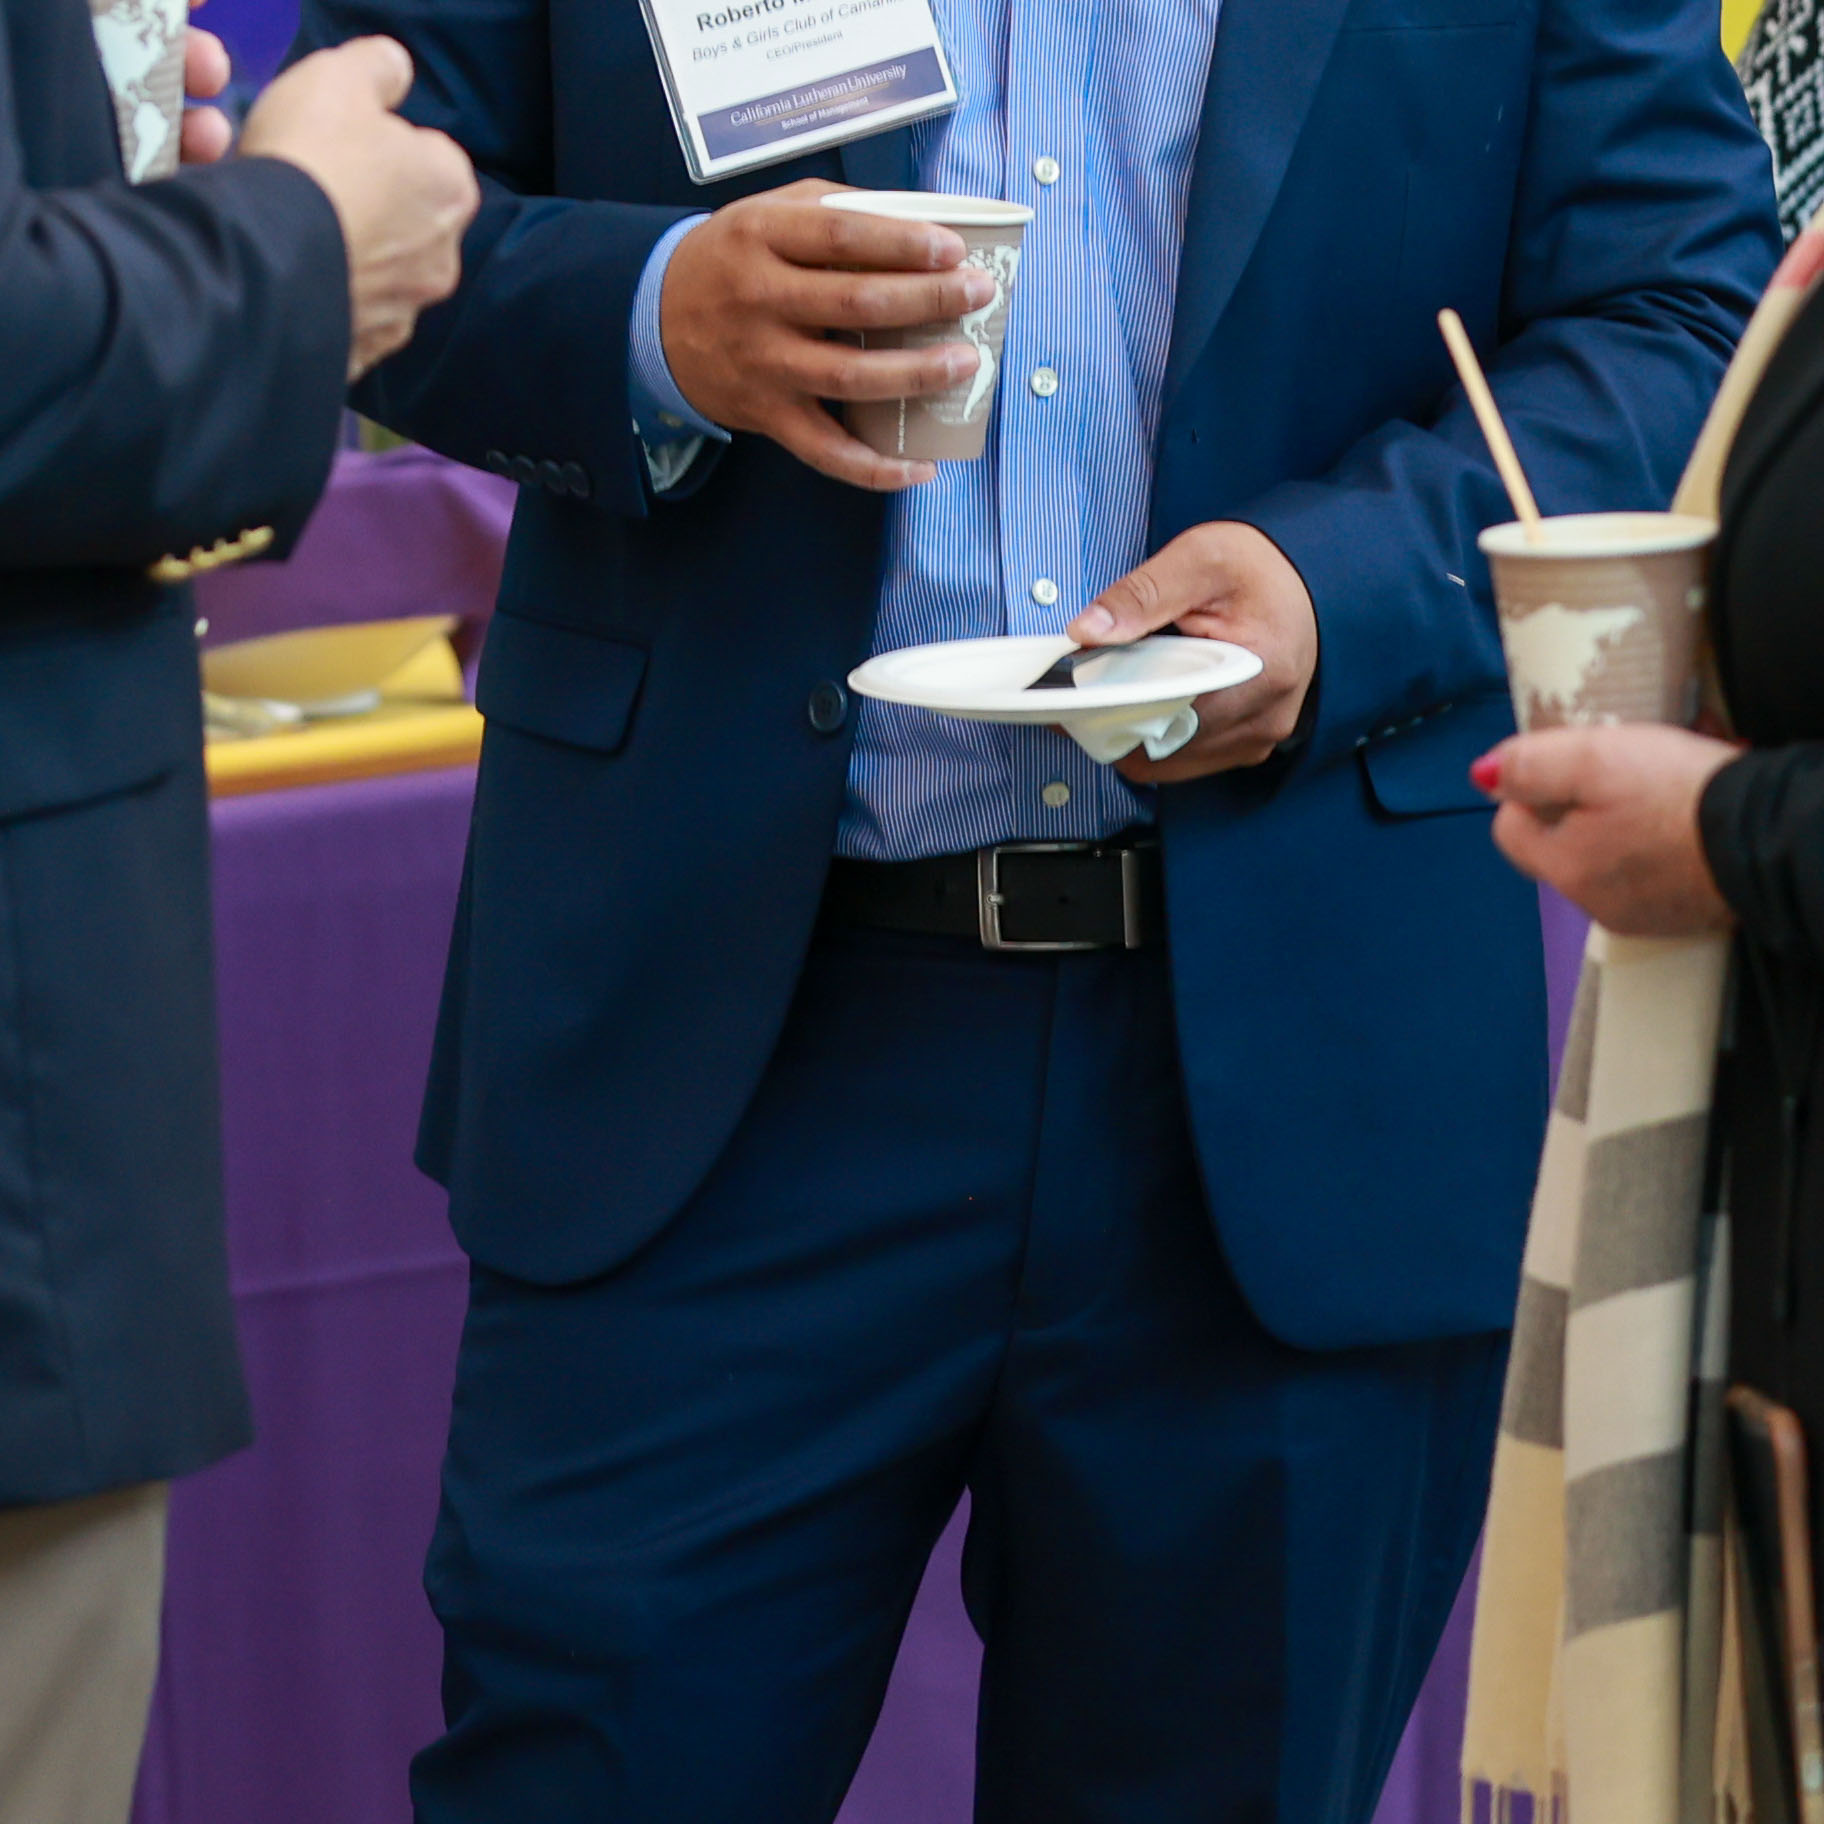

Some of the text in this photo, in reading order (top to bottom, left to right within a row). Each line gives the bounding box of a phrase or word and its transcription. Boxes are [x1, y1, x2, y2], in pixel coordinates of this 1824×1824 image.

[692, 43, 727, 62] Boys
[732, 37, 742, 50] &
[747, 25, 779, 45] Girls
[784, 14, 817, 34] Club
[820, 9, 833, 23] of
[766, 30, 844, 60] CEO/President
[730, 64, 907, 126] California Lutheran University
[781, 96, 870, 130] School of Management
